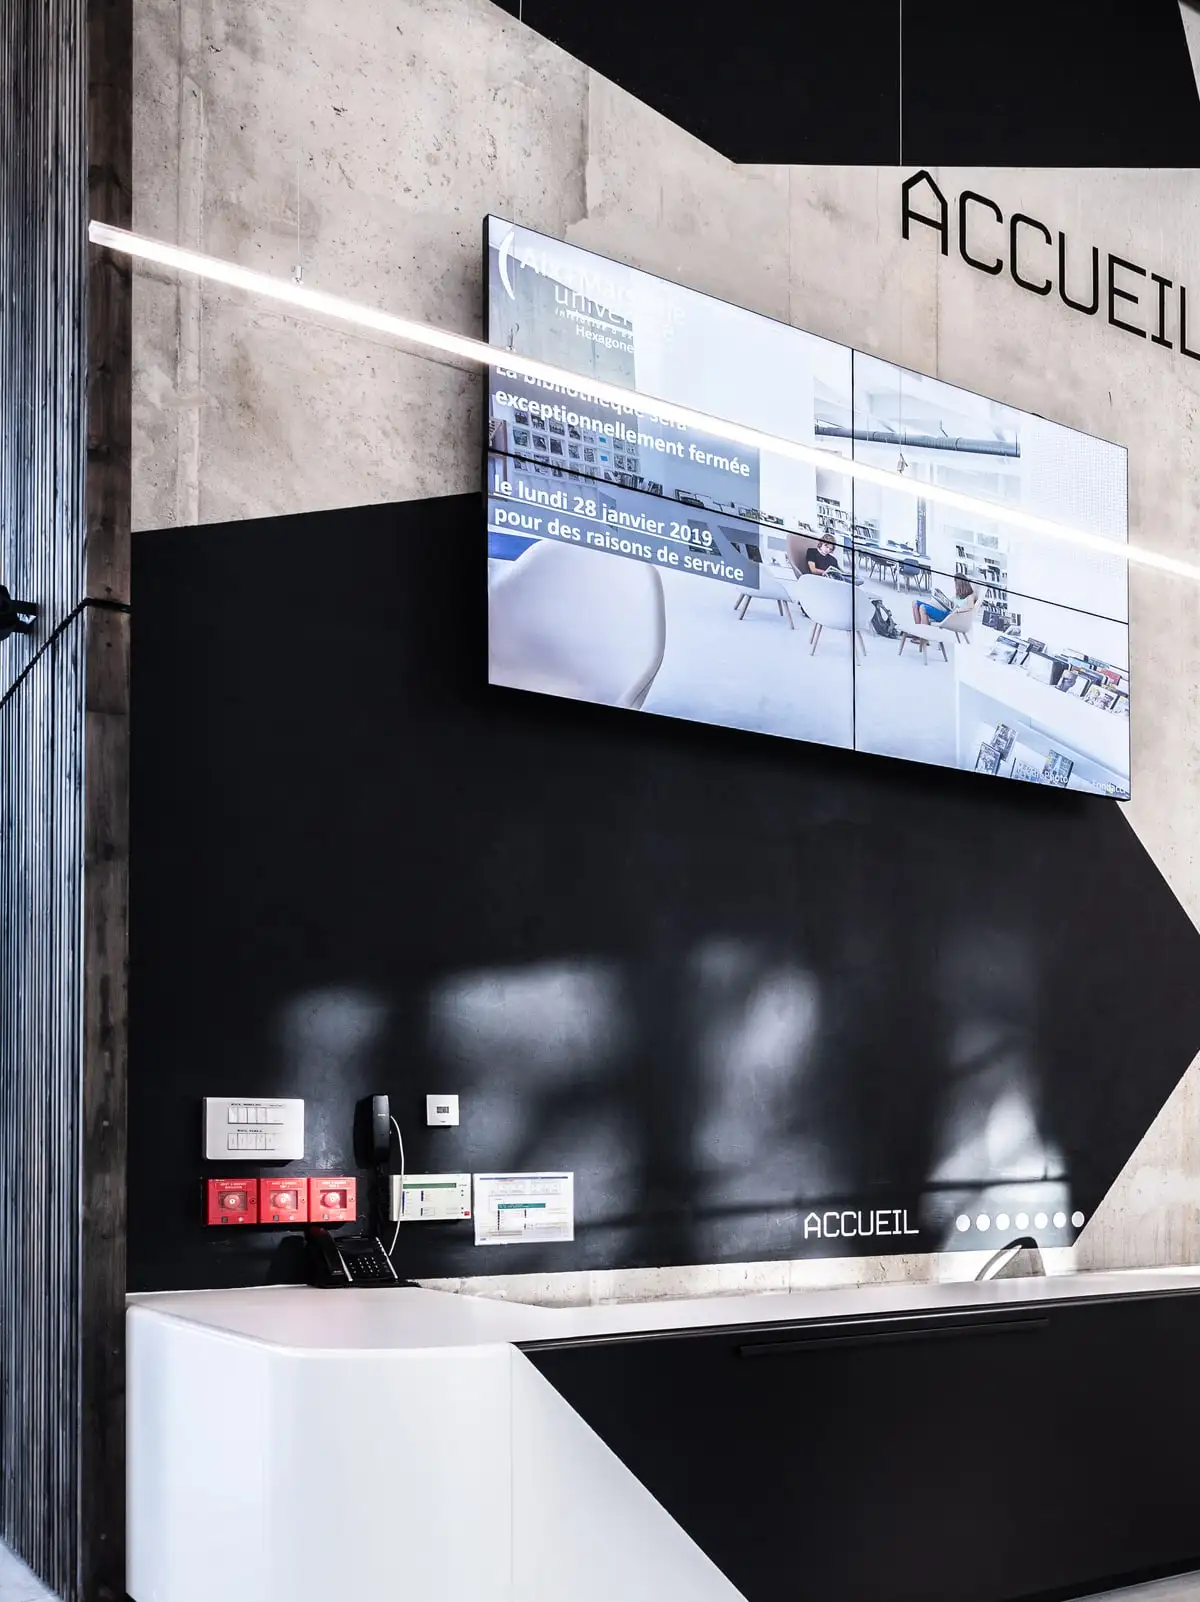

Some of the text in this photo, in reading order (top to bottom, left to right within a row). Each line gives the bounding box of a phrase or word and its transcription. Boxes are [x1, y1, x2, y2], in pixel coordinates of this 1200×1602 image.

[575, 324, 636, 355] Hexagone
[494, 388, 751, 477] exceptionnellement fermée
[494, 473, 713, 547] le lundi 28 janvier 2019
[494, 506, 744, 582] pour des raisons de service
[803, 1209, 919, 1240] ACCUEIL
